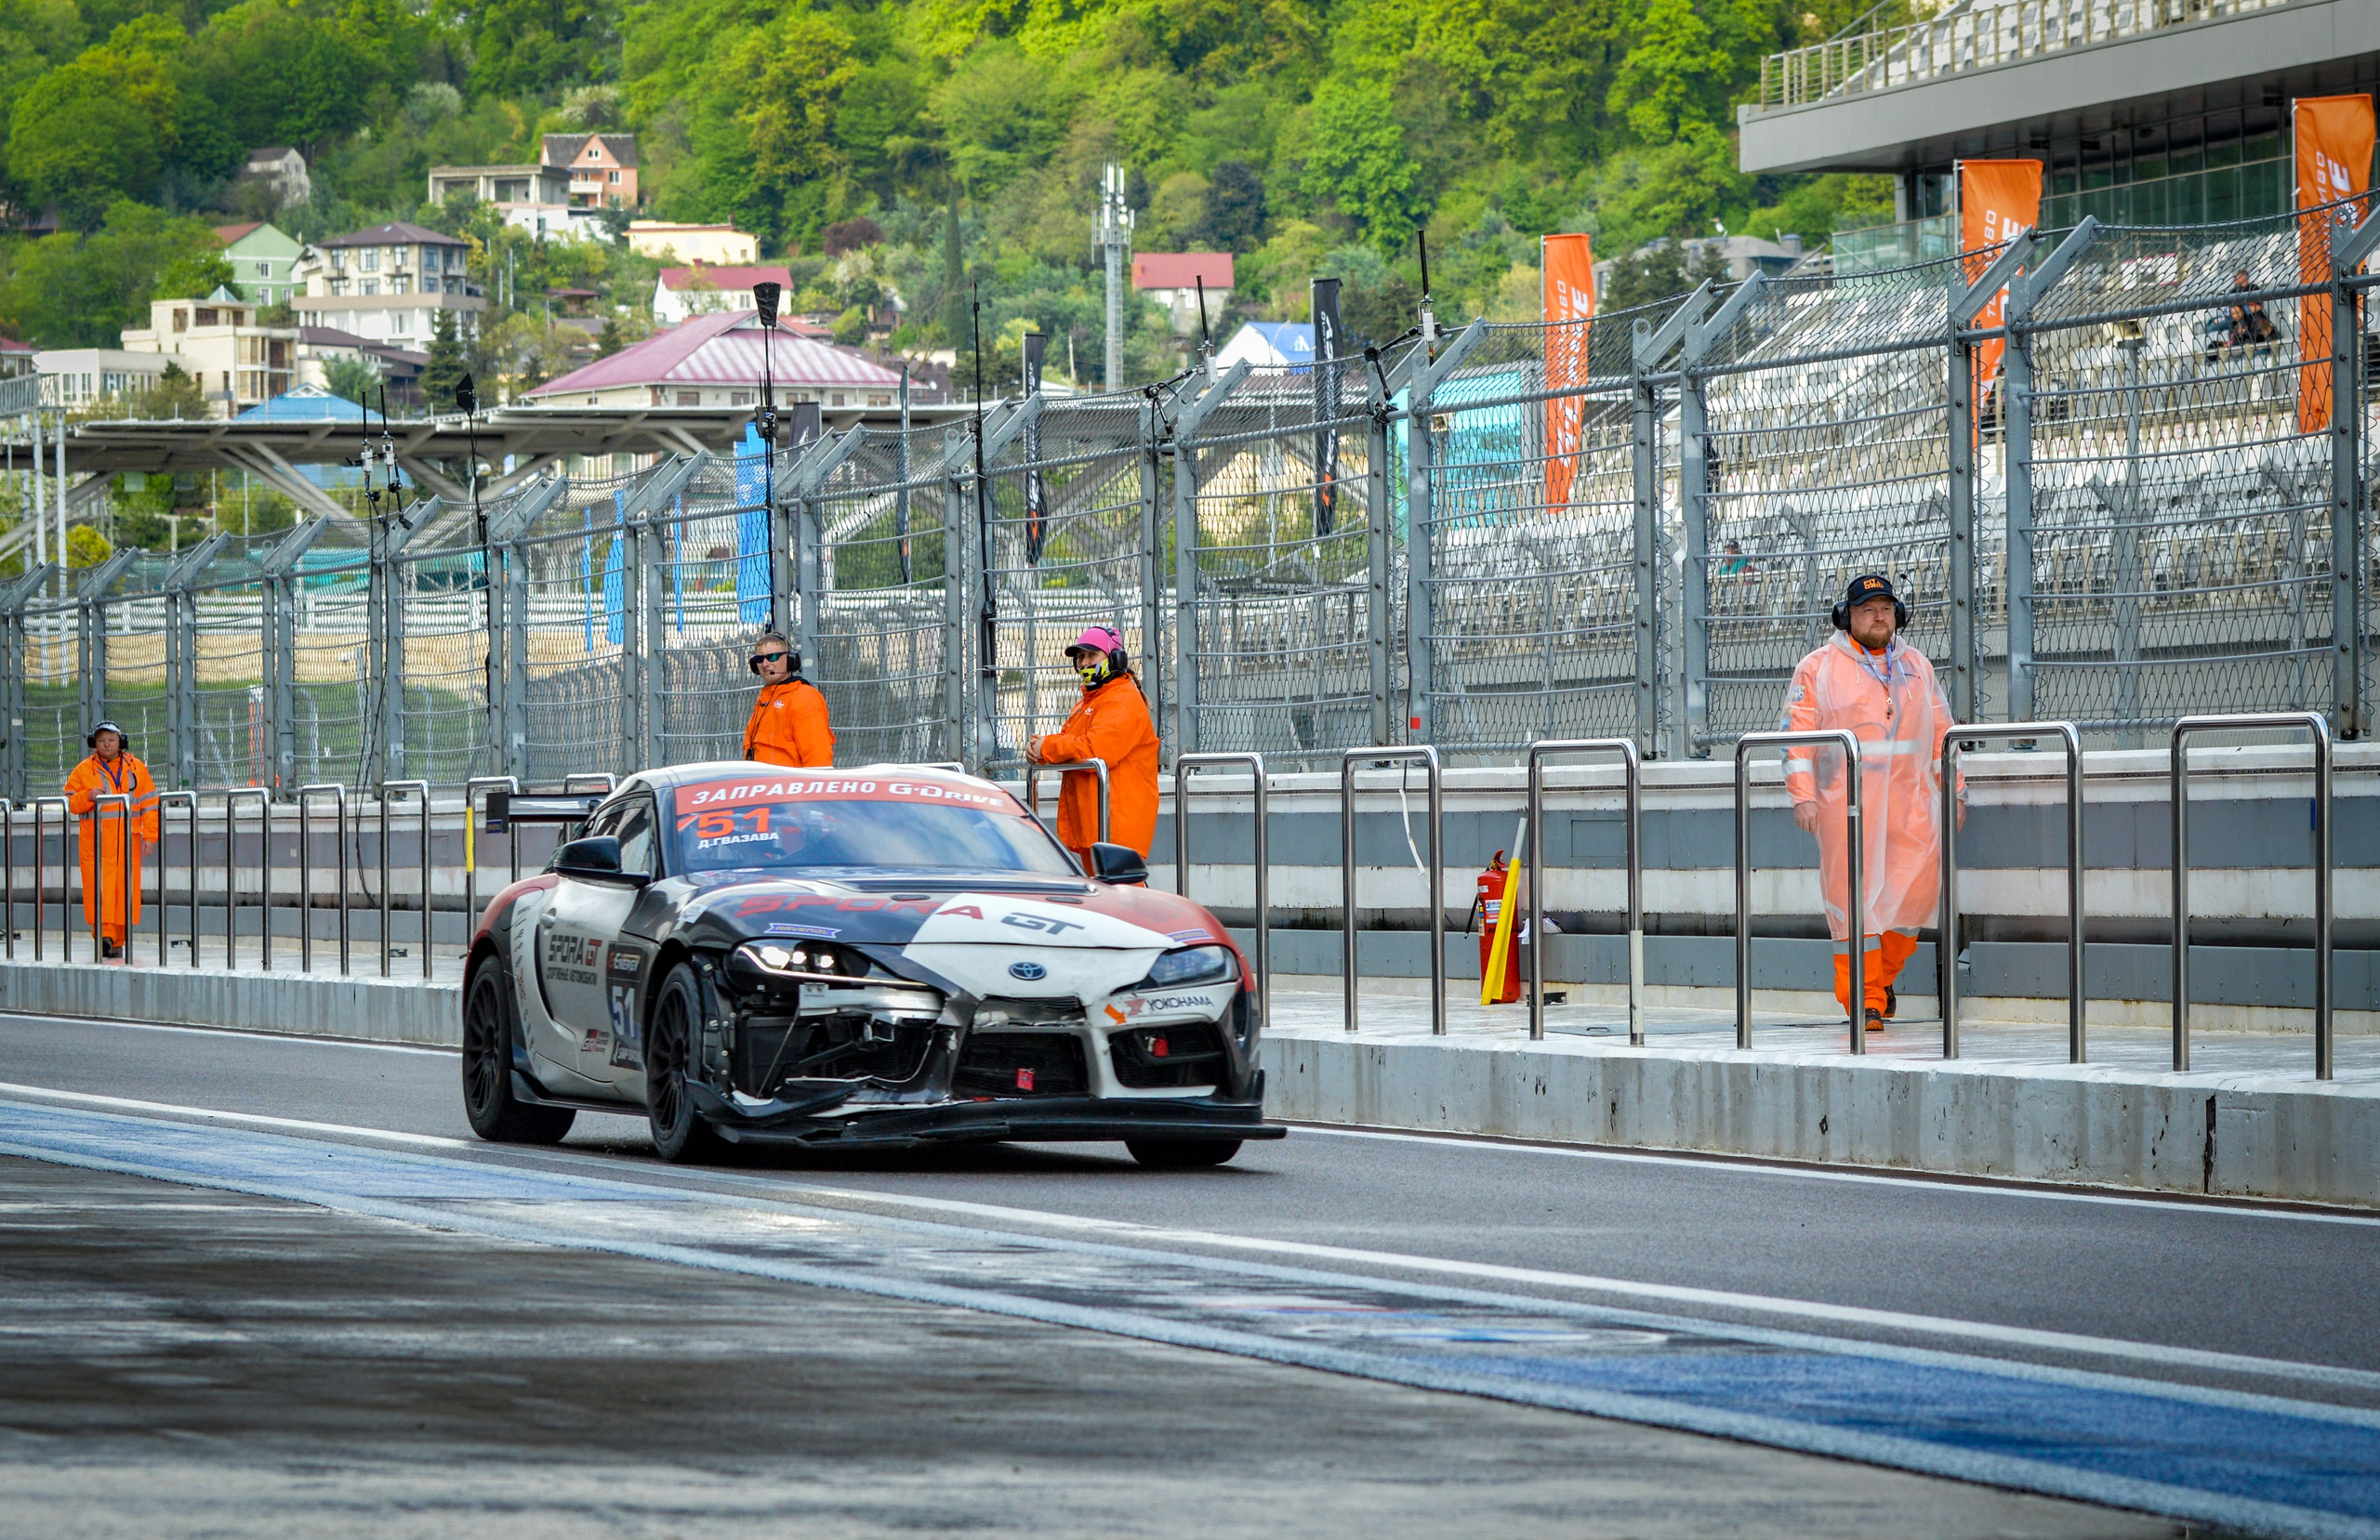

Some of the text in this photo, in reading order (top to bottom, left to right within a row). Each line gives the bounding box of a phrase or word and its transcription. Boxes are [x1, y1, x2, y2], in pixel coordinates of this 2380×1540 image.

[692, 781, 877, 806] ЗАПРАВЛЕНО
[696, 807, 771, 839] 51
[697, 831, 780, 849] Д.ГВАЗАВА
[734, 894, 1085, 936] SPORA GT
[548, 934, 603, 967] SPORA GT
[612, 985, 636, 1038] 51
[1146, 995, 1214, 1011] YOKOHAMA
